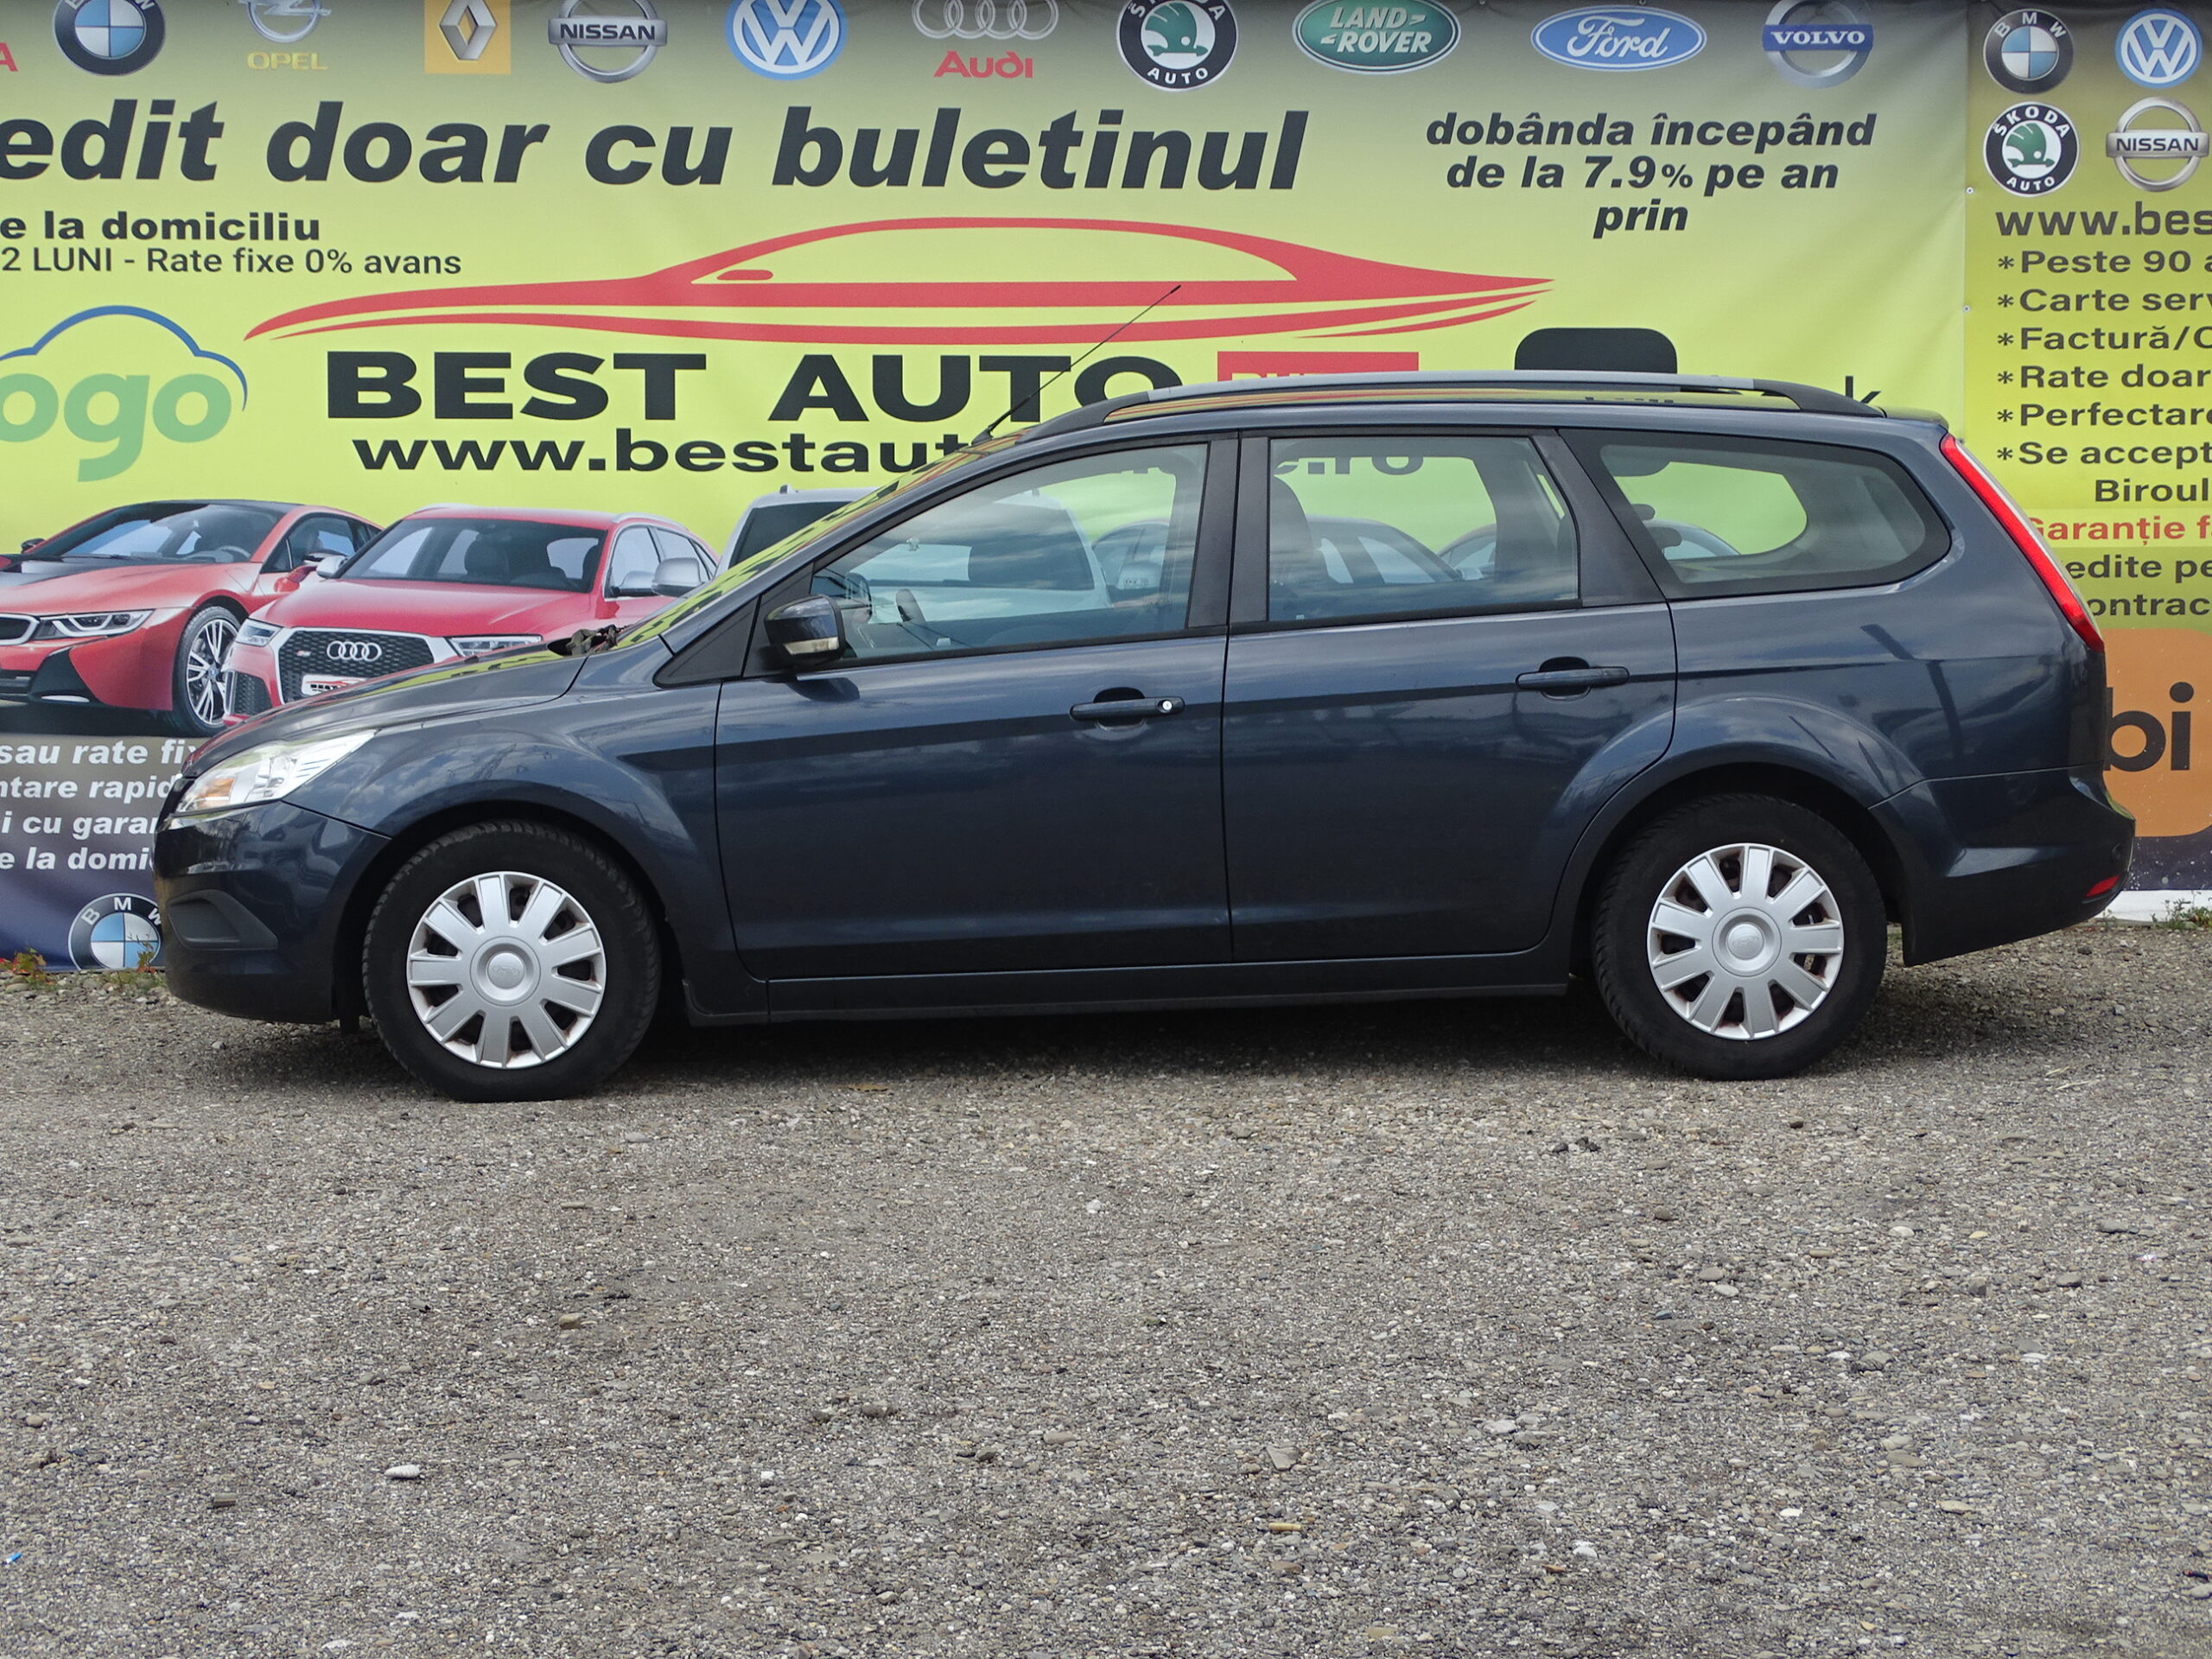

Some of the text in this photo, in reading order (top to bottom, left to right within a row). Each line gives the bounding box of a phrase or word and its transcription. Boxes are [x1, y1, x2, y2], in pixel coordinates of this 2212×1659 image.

[1330, 6, 1409, 29] LAND
[1993, 12, 2068, 38] BMW
[559, 22, 656, 41] NISSAN
[1337, 31, 1433, 54] ROVER
[1566, 16, 1669, 59] Ford
[1770, 30, 1866, 46] VOLVO
[246, 52, 327, 71] OPEL
[933, 50, 1033, 79] Audi
[1147, 66, 1209, 86] AUTO
[1426, 112, 1877, 154] dobânda începând
[2117, 138, 2199, 151] NISSAN
[266, 101, 550, 184] doar
[585, 124, 733, 185] cu
[772, 105, 1309, 190] buletinul
[1446, 156, 1839, 197] de la 7.9% pe an
[2006, 176, 2056, 192] AUTO
[44, 210, 84, 239] la
[102, 211, 320, 241] domiciliu
[1593, 198, 1688, 238] prin
[33, 247, 112, 271] LUNI
[147, 248, 222, 273] Rate
[233, 247, 295, 273] fixe
[305, 249, 353, 273] 0%
[363, 256, 461, 274] avans
[2144, 250, 2191, 273] 90
[327, 351, 1184, 423] BEST AUTO
[2121, 364, 2210, 388] doar
[2094, 478, 2209, 502] Biroul
[2063, 554, 2212, 583] edite pe
[2086, 594, 2212, 616] ontrac
[0, 744, 60, 765] sau
[72, 740, 149, 765] rate
[22, 817, 62, 835] cu
[25, 847, 56, 869] la
[67, 847, 154, 870] domi
